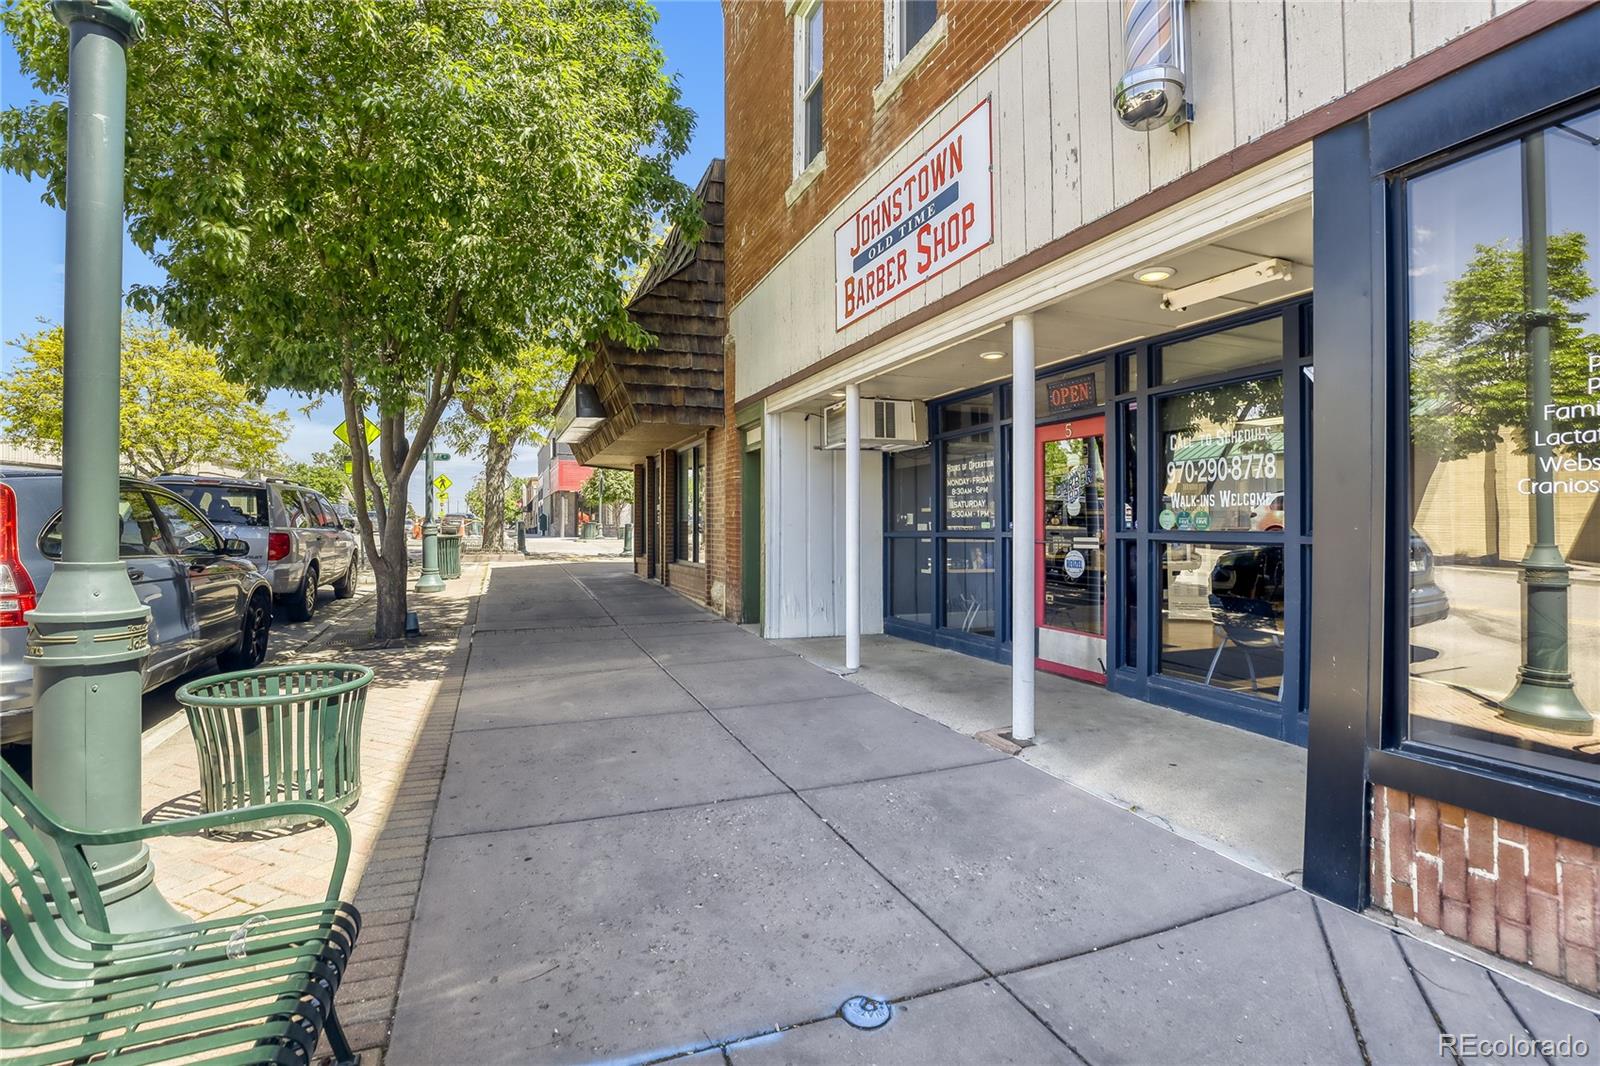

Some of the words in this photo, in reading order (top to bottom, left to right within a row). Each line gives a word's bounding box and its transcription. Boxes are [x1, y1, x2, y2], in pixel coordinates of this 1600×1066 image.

[850, 134, 964, 258] JOHNSTOWN
[868, 237, 893, 259] OLD
[898, 203, 936, 236] TIME
[844, 249, 908, 320] BARBER
[916, 202, 975, 275] SHOP
[1051, 382, 1089, 406] OPEN
[1064, 423, 1072, 438] 5
[1170, 433, 1194, 451] CALL
[1200, 433, 1212, 447] TO
[1216, 427, 1272, 447] SCHEDULE
[946, 464, 961, 472] HOURS
[968, 460, 994, 471] OPERATION
[976, 486, 988, 494] 5PM
[1170, 491, 1215, 509] WALK-INS
[1219, 489, 1272, 508] WELCOME
[954, 500, 986, 508] SATURDAY
